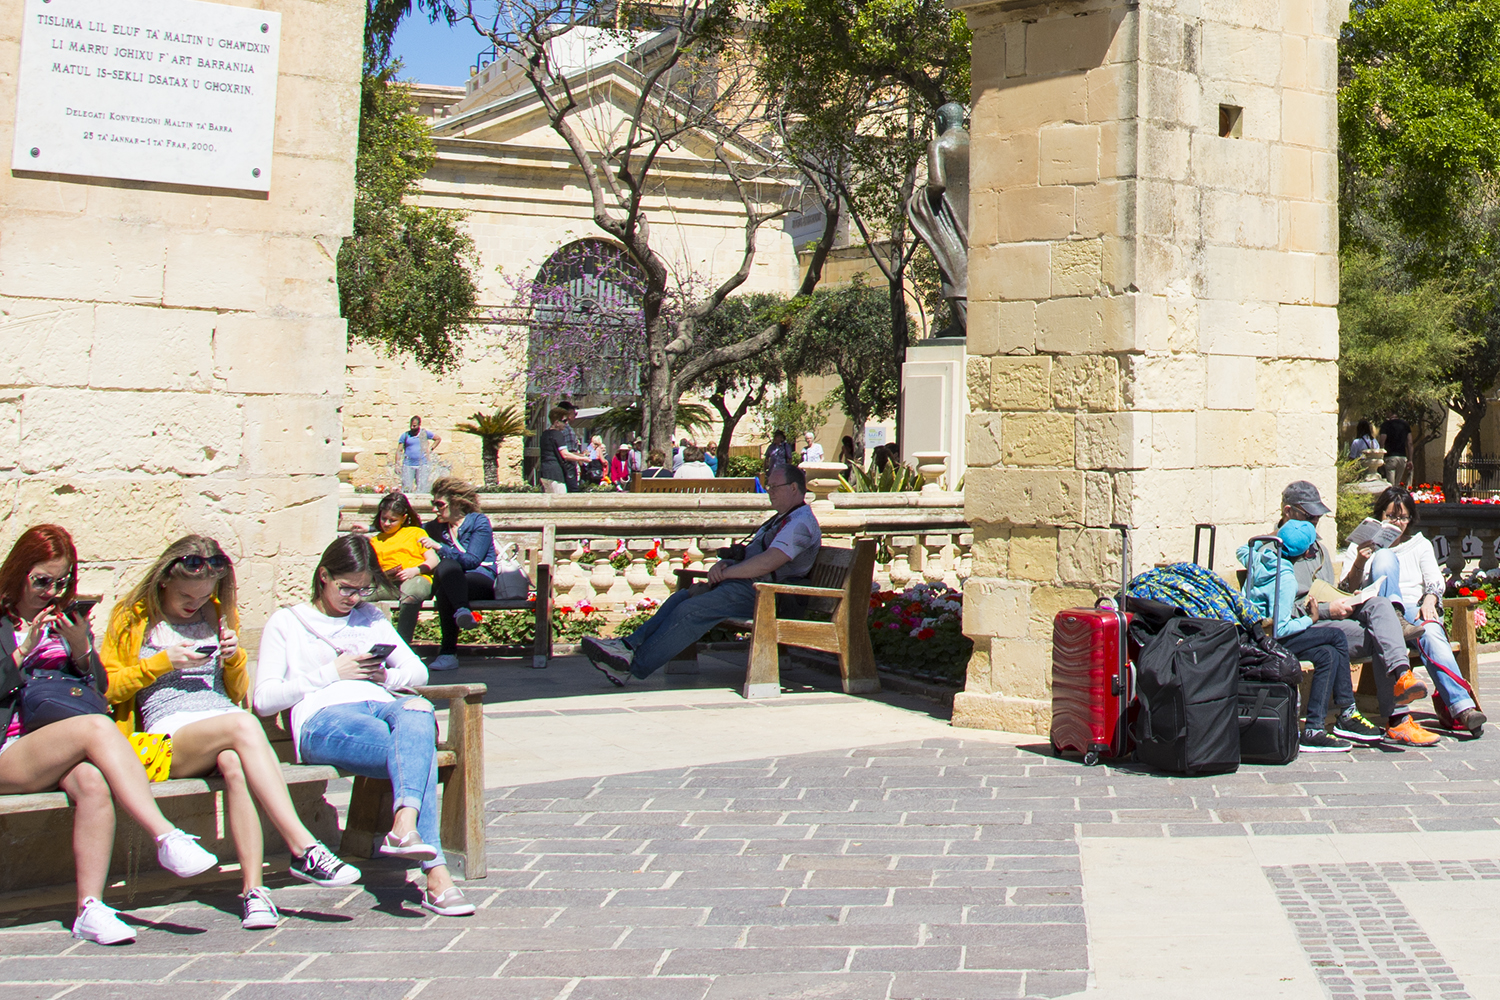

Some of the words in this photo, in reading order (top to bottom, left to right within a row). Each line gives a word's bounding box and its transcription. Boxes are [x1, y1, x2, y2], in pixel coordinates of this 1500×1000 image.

[37, 15, 82, 29] TISLIMA
[89, 22, 107, 32] LIL
[112, 25, 140, 36] ELUF
[164, 32, 203, 44] MALTIN
[207, 38, 214, 46] U
[52, 39, 63, 49] LI
[69, 42, 108, 55] MARRU
[171, 56, 192, 65] ART
[197, 58, 254, 73] BARRANIJA
[52, 63, 91, 76] MATUL
[97, 68, 143, 82] IS-SEKLI
[149, 75, 188, 87] DSATAX
[193, 80, 199, 89] U
[164, 119, 192, 127] MALTIN
[209, 123, 232, 132] BARRA
